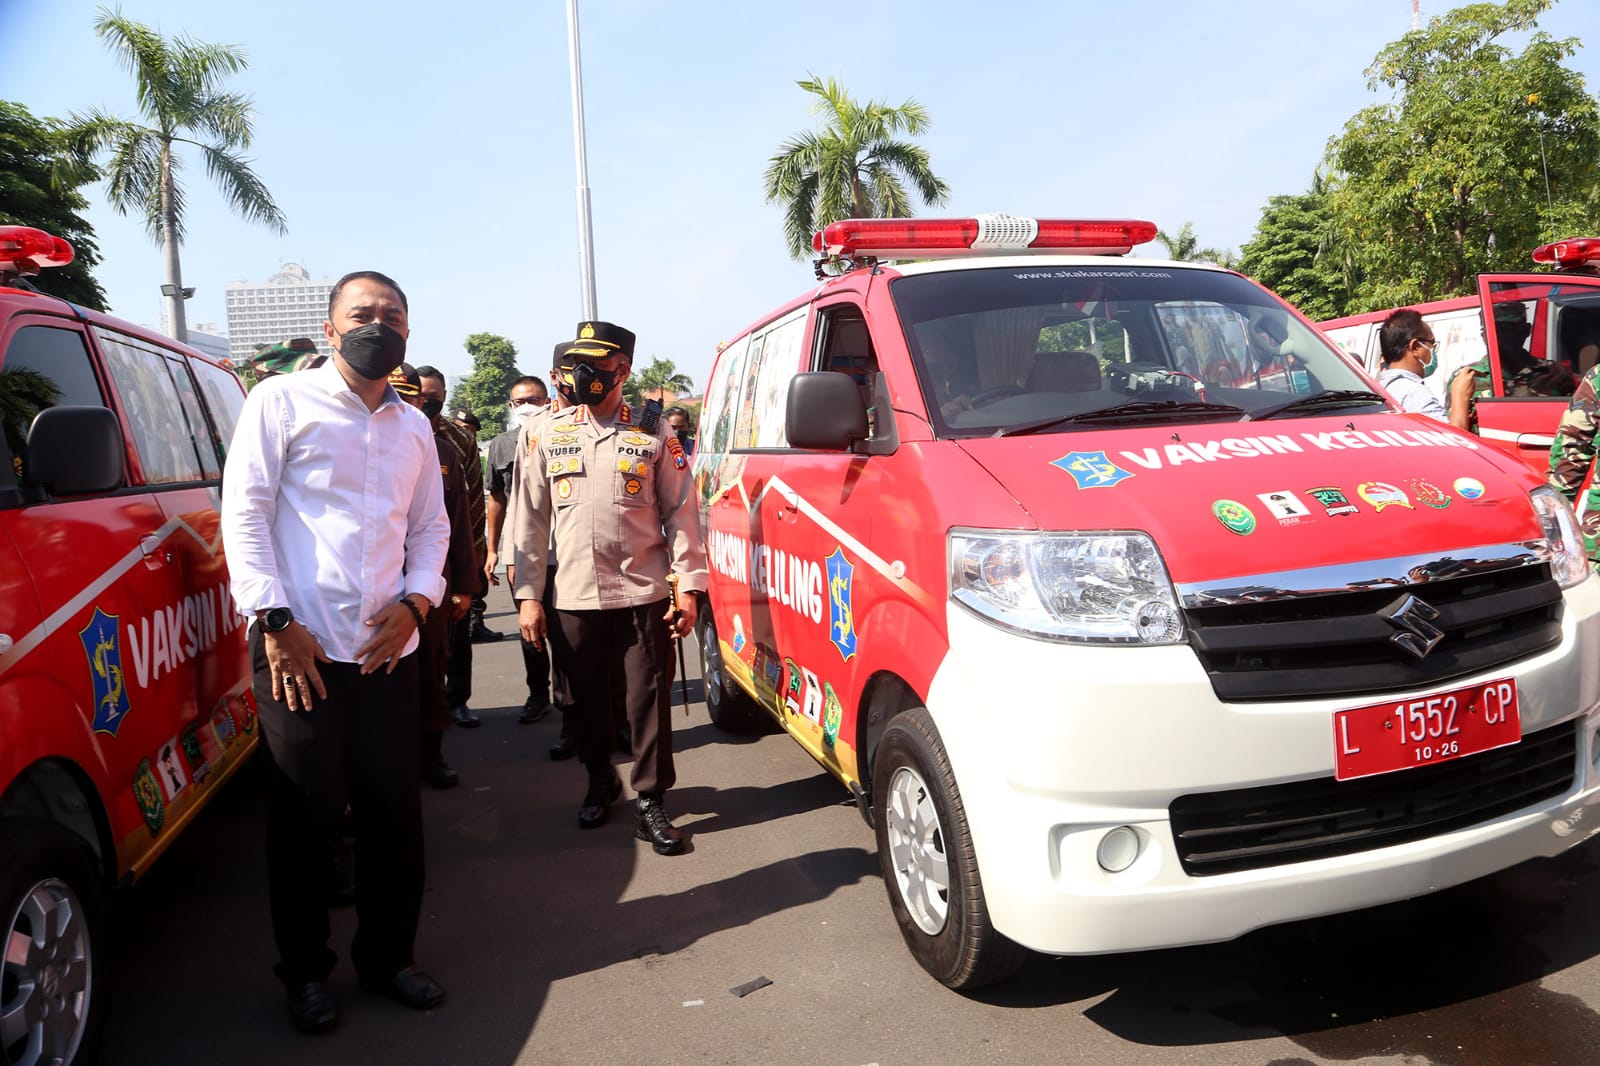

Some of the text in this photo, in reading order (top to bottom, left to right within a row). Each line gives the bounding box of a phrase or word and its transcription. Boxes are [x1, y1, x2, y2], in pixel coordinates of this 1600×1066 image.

[548, 446, 582, 457] YUSEP
[617, 446, 655, 459] POLRI
[1120, 429, 1480, 470] VAKSIN KELILING
[708, 529, 822, 624] VAKSIN KELILING
[127, 587, 217, 689] VAKSIN
[1340, 683, 1512, 755] L 1552 CP
